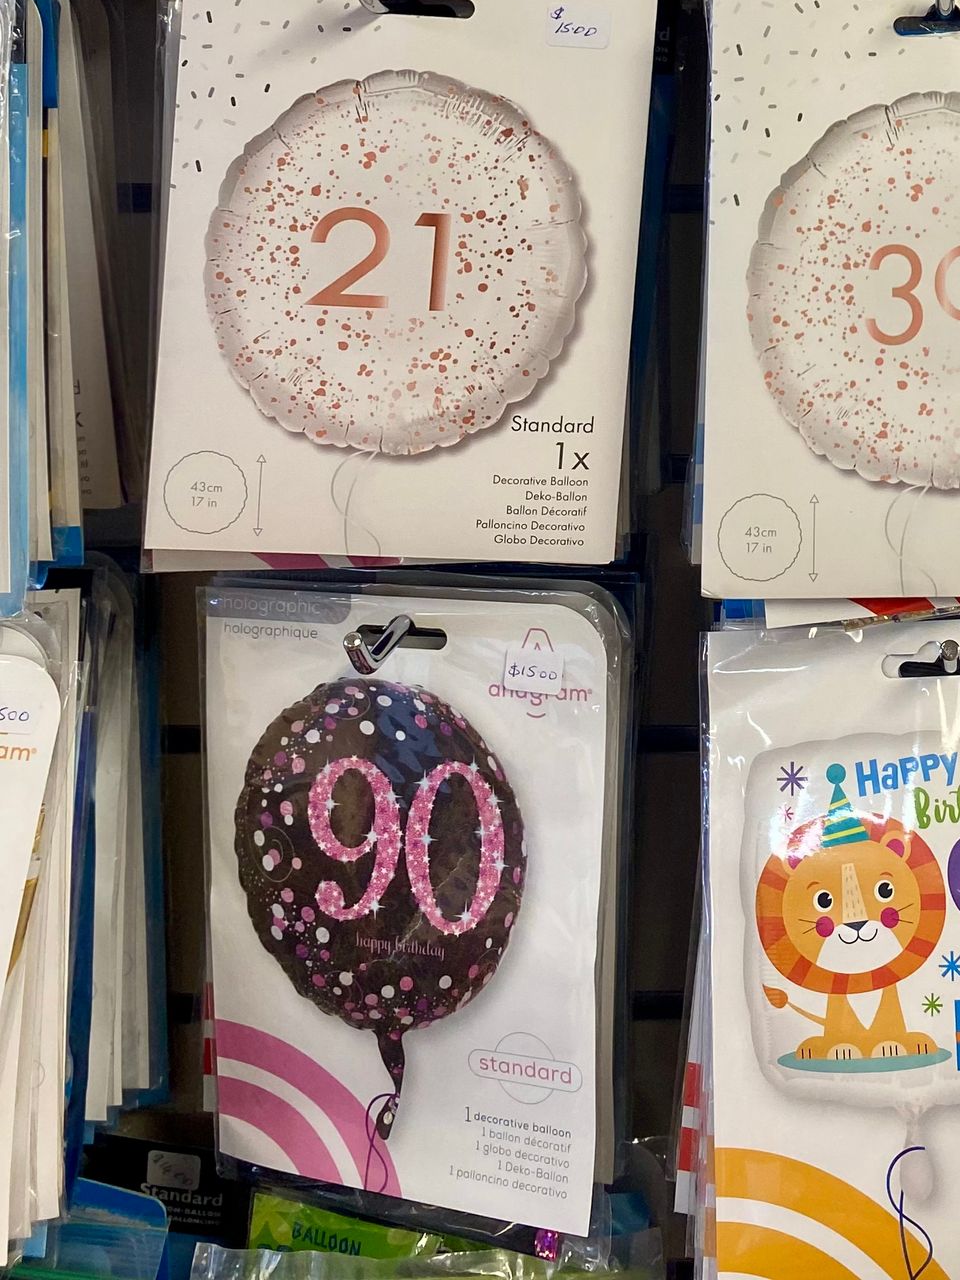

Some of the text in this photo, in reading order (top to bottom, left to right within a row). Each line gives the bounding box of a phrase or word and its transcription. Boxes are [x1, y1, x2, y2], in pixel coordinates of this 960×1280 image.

[550, 6, 565, 20] $
[303, 206, 454, 312] 21
[511, 415, 595, 434] Standard
[555, 441, 590, 471] 1x
[190, 481, 223, 493] 43cm
[492, 474, 589, 487] Decorative Balloon
[191, 496, 218, 508] 17 in
[525, 490, 588, 502] Deko-Ballon
[506, 505, 588, 517] Ballon Décoratif
[475, 519, 586, 532] Palloncino Decorativo
[744, 526, 777, 538] 43cm
[493, 534, 585, 547] Globo Decorativo
[746, 542, 773, 554] 17 in
[223, 622, 319, 640] holographique
[307, 756, 506, 937] 90
[479, 1056, 572, 1085] standard
[464, 1106, 572, 1139] 1 decorative balloon
[292, 1221, 362, 1256] BALLOON
